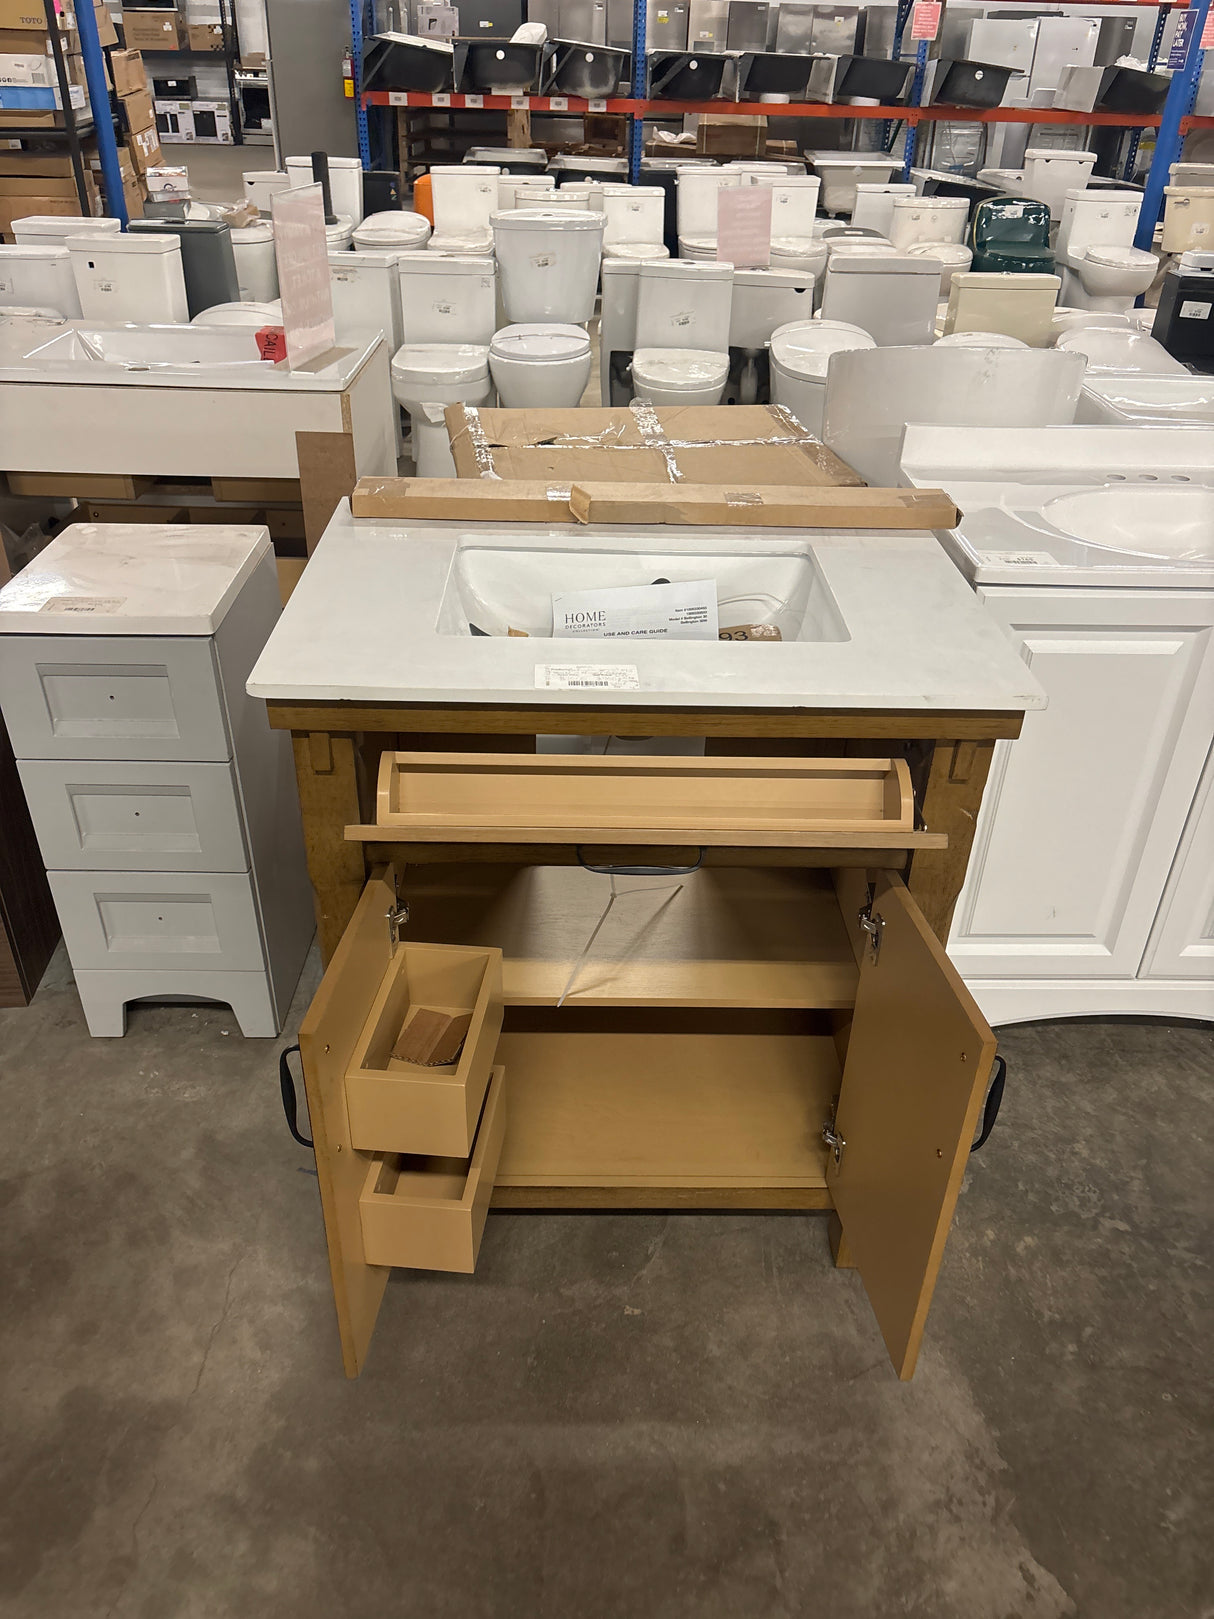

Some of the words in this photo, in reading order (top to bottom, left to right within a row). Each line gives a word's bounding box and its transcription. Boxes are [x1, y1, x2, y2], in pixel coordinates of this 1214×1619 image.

[20, 16, 43, 24] TOTO
[565, 610, 606, 624] HOME
[565, 622, 606, 630] DECORATORS
